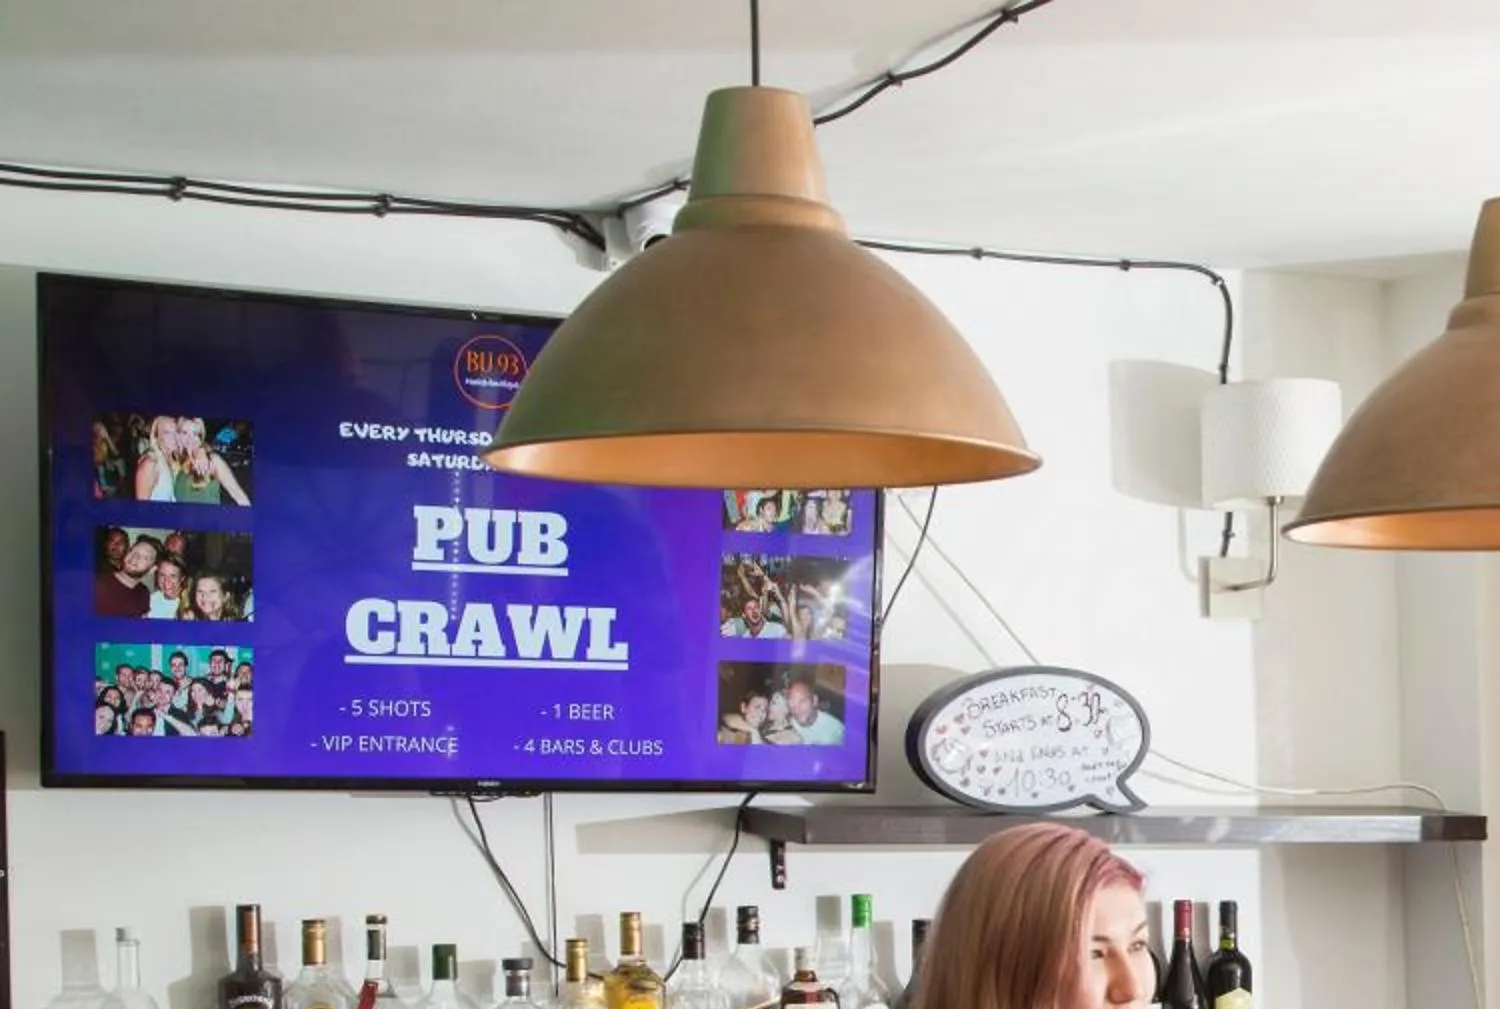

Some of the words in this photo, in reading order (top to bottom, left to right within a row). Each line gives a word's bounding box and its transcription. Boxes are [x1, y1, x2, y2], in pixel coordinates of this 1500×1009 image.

[466, 350, 494, 373] BU
[497, 353, 519, 376] 93
[339, 421, 410, 440] EVERY
[413, 426, 493, 446] THURSD
[406, 452, 497, 471] SATURD
[412, 505, 569, 567] PUB
[345, 597, 629, 662] CRAWL
[351, 700, 362, 717] 5
[366, 699, 432, 717] SHOTS
[553, 703, 561, 719] 1
[568, 703, 615, 720] BEER
[322, 735, 353, 752] VIP
[358, 735, 459, 754] ENTRANCE
[523, 738, 535, 753] 4
[541, 739, 585, 755] BARS
[589, 739, 603, 756] &
[608, 739, 664, 756] CLUBS
